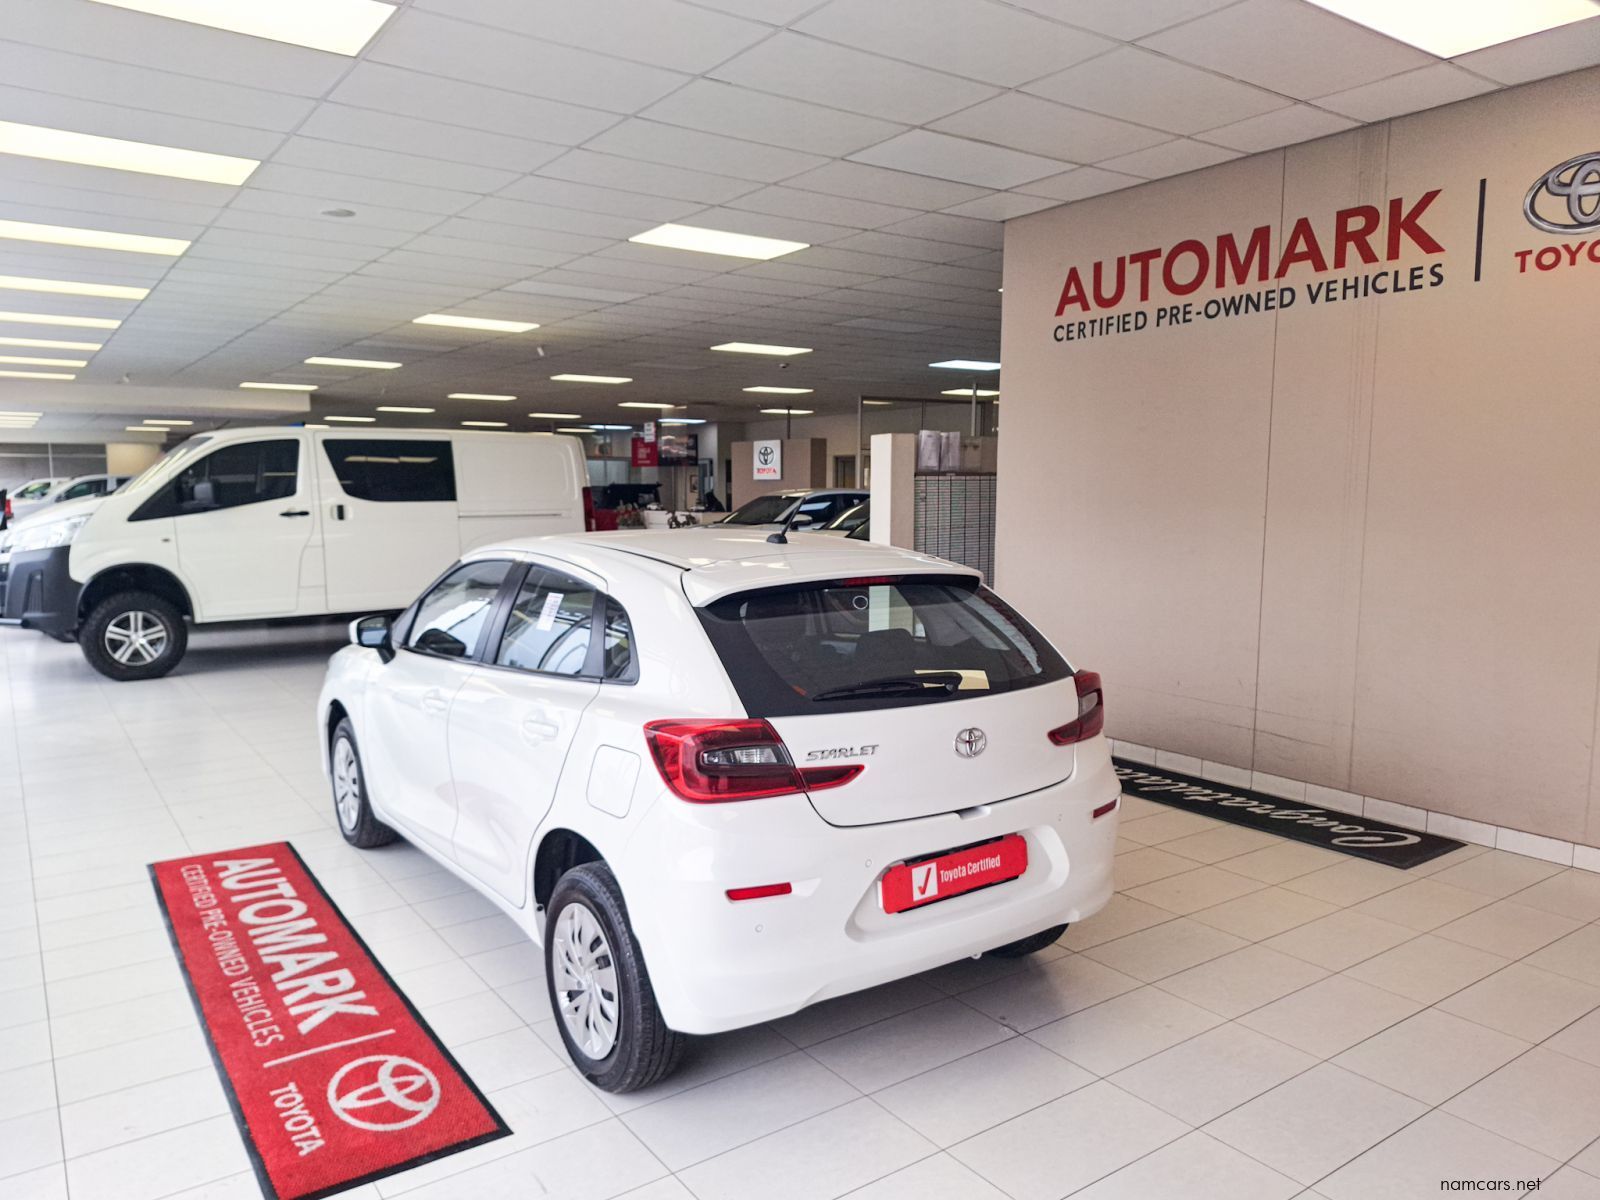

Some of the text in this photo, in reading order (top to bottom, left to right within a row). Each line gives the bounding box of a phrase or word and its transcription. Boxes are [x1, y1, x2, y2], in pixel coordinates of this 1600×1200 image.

[1054, 188, 1446, 316] AUTOMARK
[1053, 262, 1445, 342] CERTIFIED PRE-OWNED VEHICLES
[806, 744, 880, 761] STARLET
[940, 854, 1001, 883] Toyota Certified
[180, 863, 285, 1048] CERTIFIED PRE-OWNED VEHICLES
[213, 857, 380, 1036] AUTOMARK
[270, 1082, 326, 1157] TOYOTA
